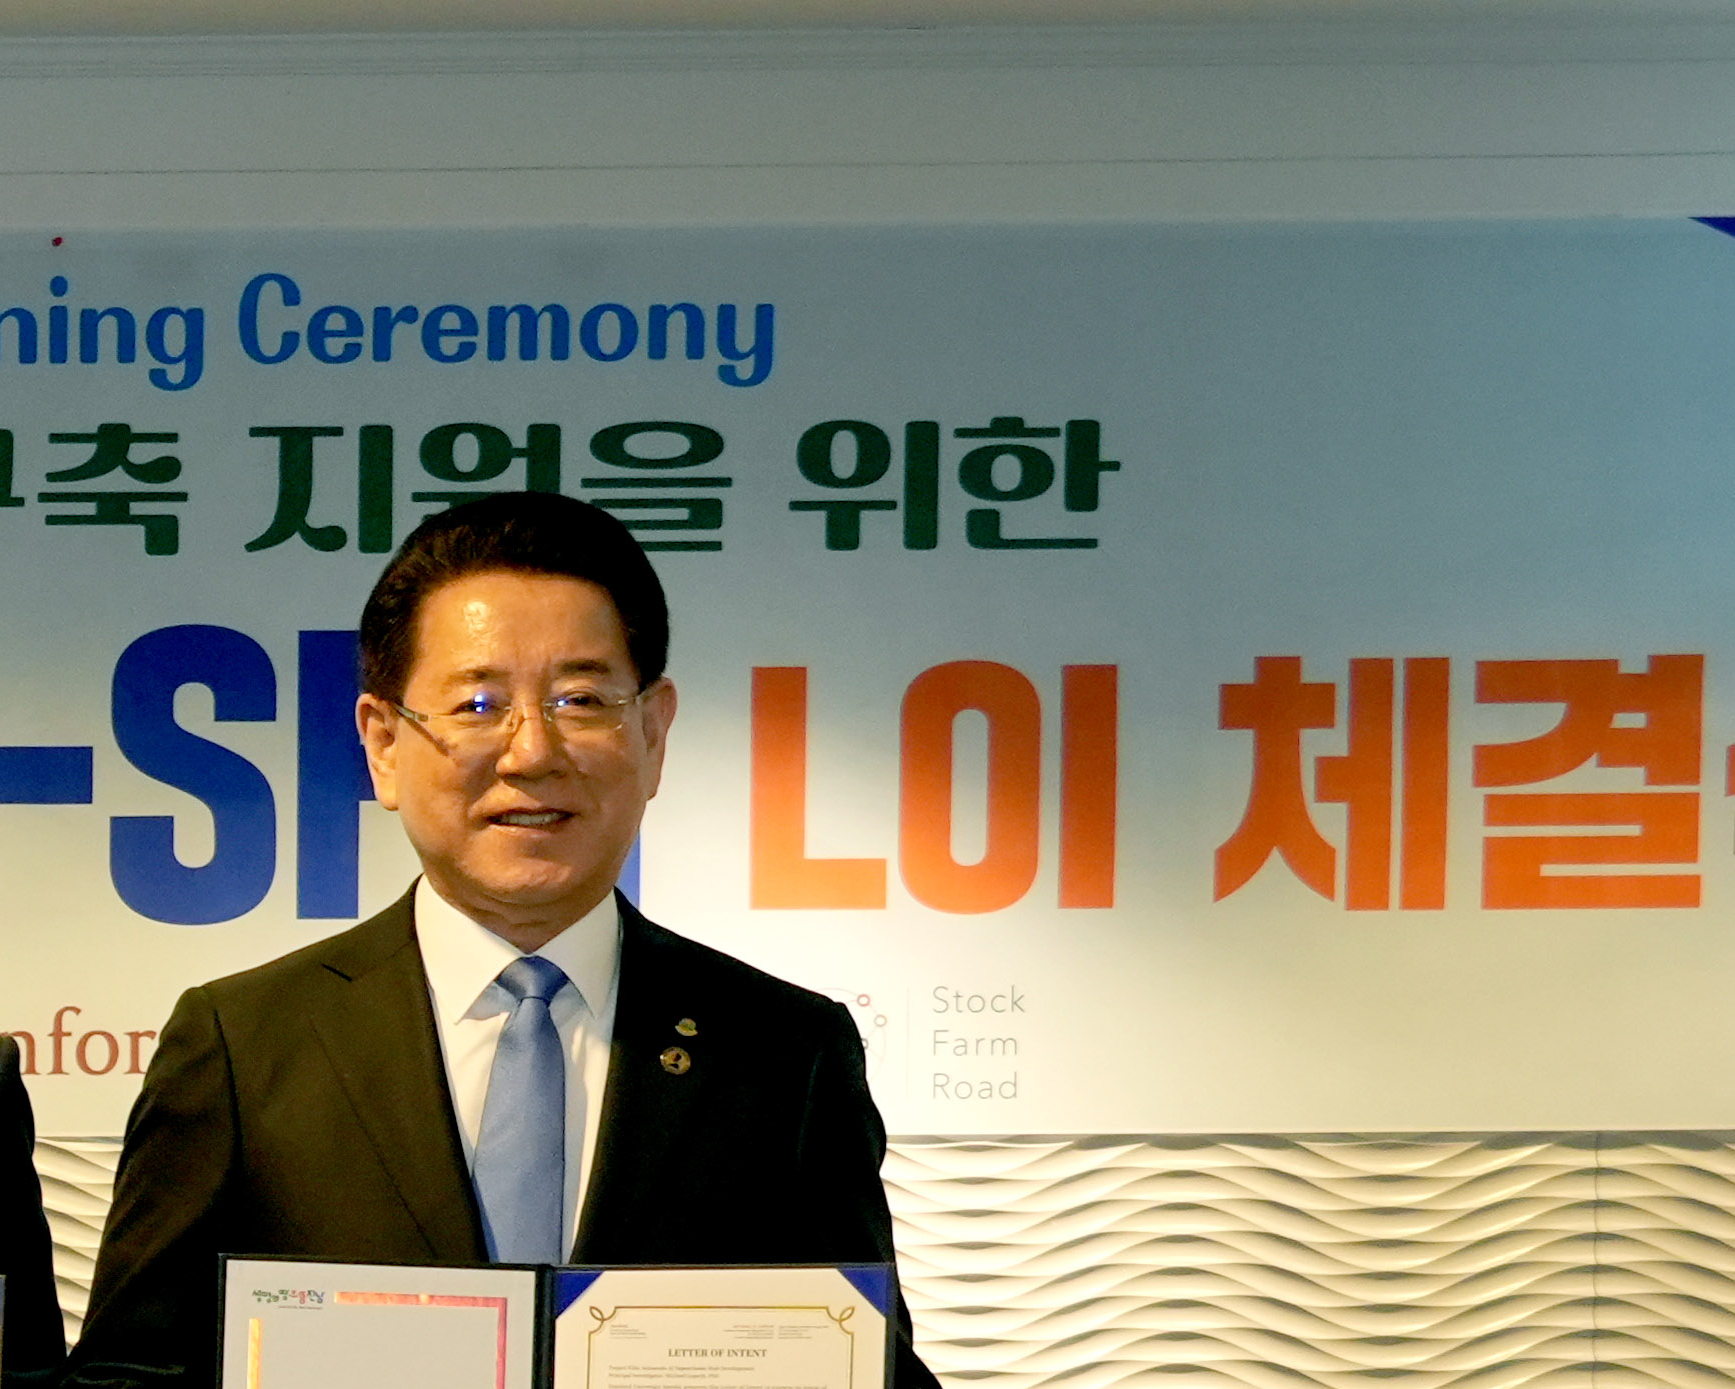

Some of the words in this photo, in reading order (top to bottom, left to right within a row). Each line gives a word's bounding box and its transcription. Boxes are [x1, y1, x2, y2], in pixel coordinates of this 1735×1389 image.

[238, 273, 775, 387] Ceremony
[789, 417, 1121, 552] 위한
[750, 660, 1118, 914] LOI
[1216, 654, 1735, 911] 체결
[932, 984, 1026, 1014] Stock
[0, 1006, 157, 1076] nfor
[932, 1029, 1019, 1056] Farm
[932, 1071, 1019, 1100] Road
[667, 1348, 708, 1358] LETTER
[710, 1348, 725, 1358] OF
[726, 1348, 768, 1358] INTENT
